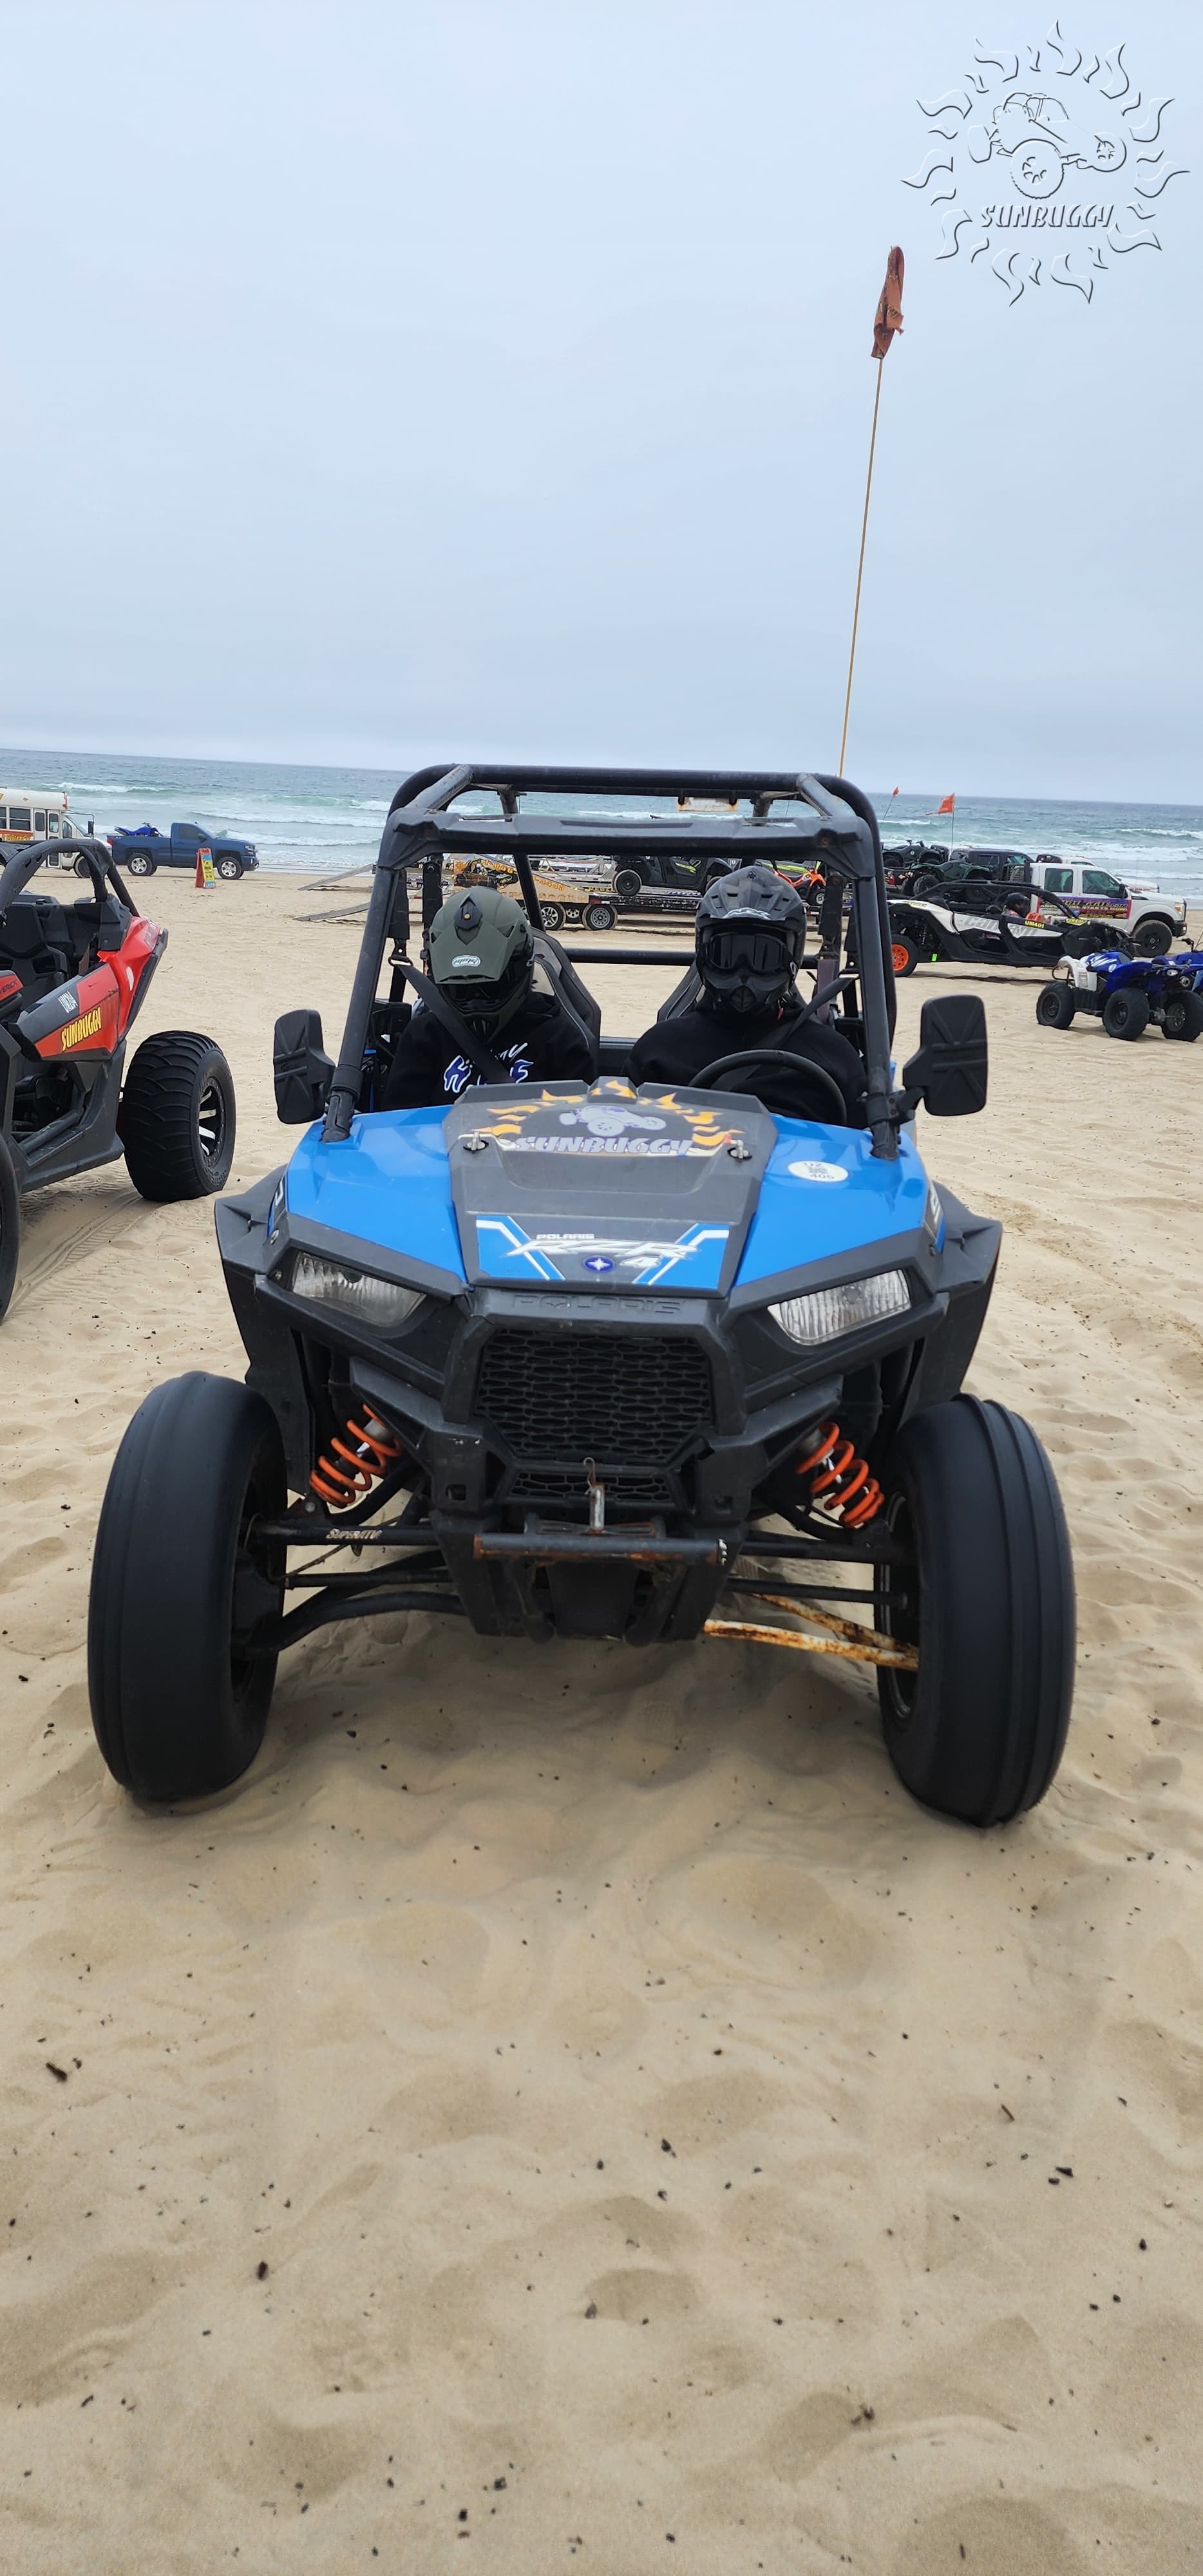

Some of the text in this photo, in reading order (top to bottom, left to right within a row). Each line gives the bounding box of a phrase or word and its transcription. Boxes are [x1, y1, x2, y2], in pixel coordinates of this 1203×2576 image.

[1025, 920, 1045, 929] UM401
[61, 1007, 102, 1052] SUNBUGGY
[516, 1136, 694, 1155] SUNBUGGY
[504, 1238, 699, 1258] RZR
[514, 1294, 681, 1314] POLARIS
